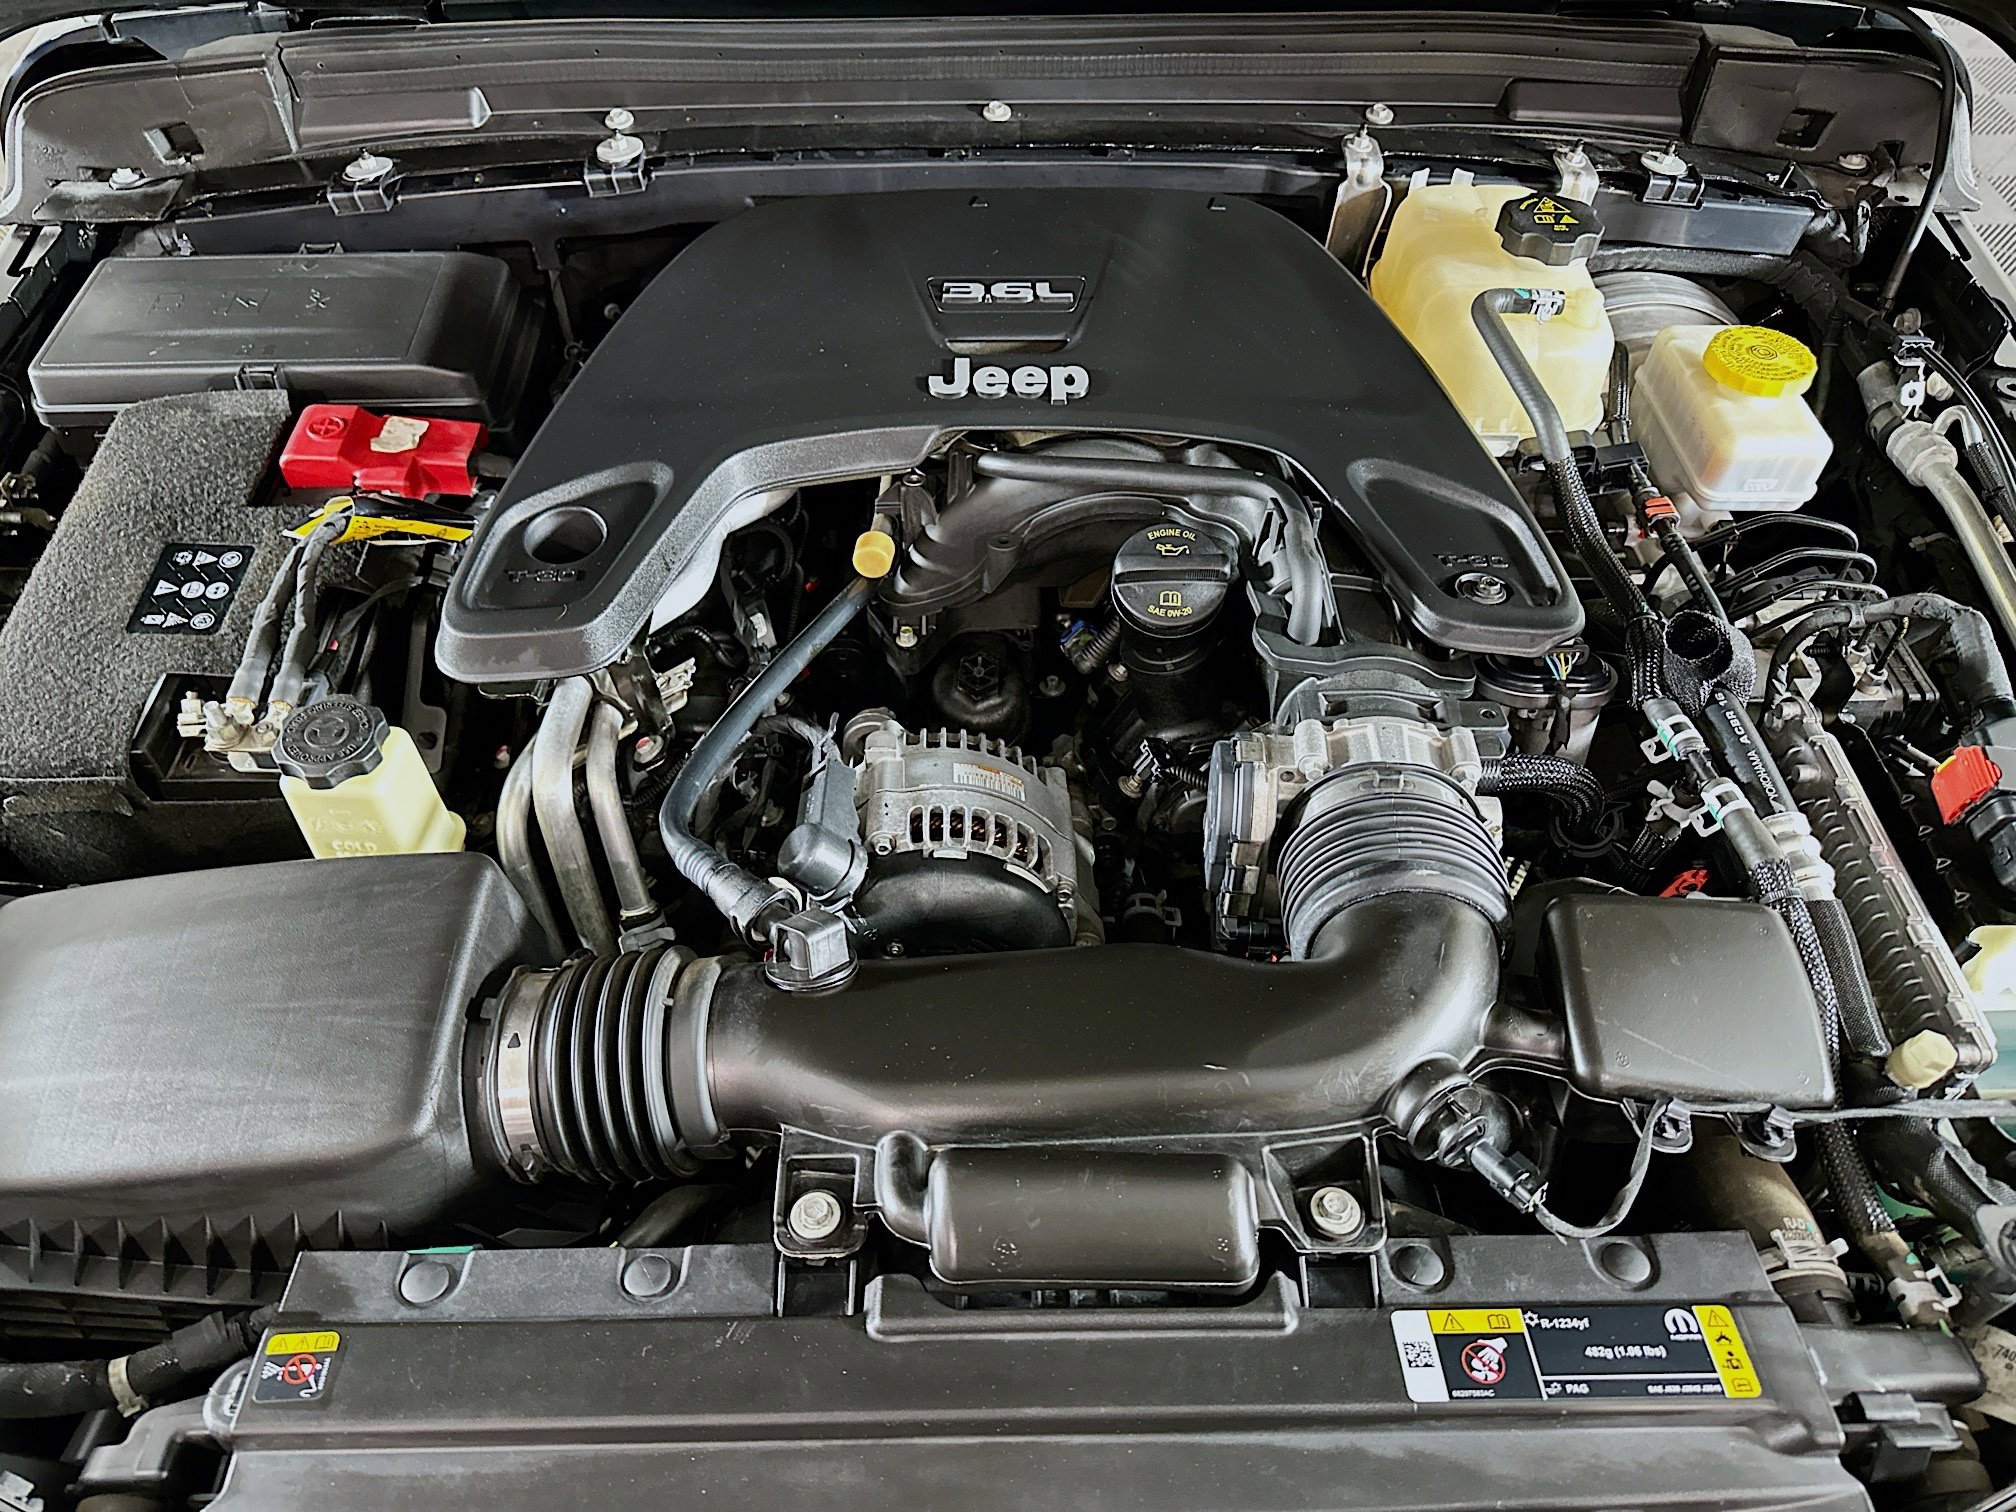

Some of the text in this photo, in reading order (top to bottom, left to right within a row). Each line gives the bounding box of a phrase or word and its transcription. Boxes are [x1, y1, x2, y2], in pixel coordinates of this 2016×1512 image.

[942, 282, 1073, 303] 3.6L
[928, 357, 1089, 405] Jeep
[1147, 528, 1196, 541] ENGINE OIL
[1147, 604, 1192, 617] SAE 0W-20
[1714, 692, 1779, 800] YOKOHAMA ACBR 16
[287, 744, 336, 763] APPROVED
[331, 840, 378, 852] COLD
[1782, 1217, 1806, 1230] RAD
[1540, 1317, 1590, 1331] R-1234yf
[1565, 1383, 1590, 1394] PAG
